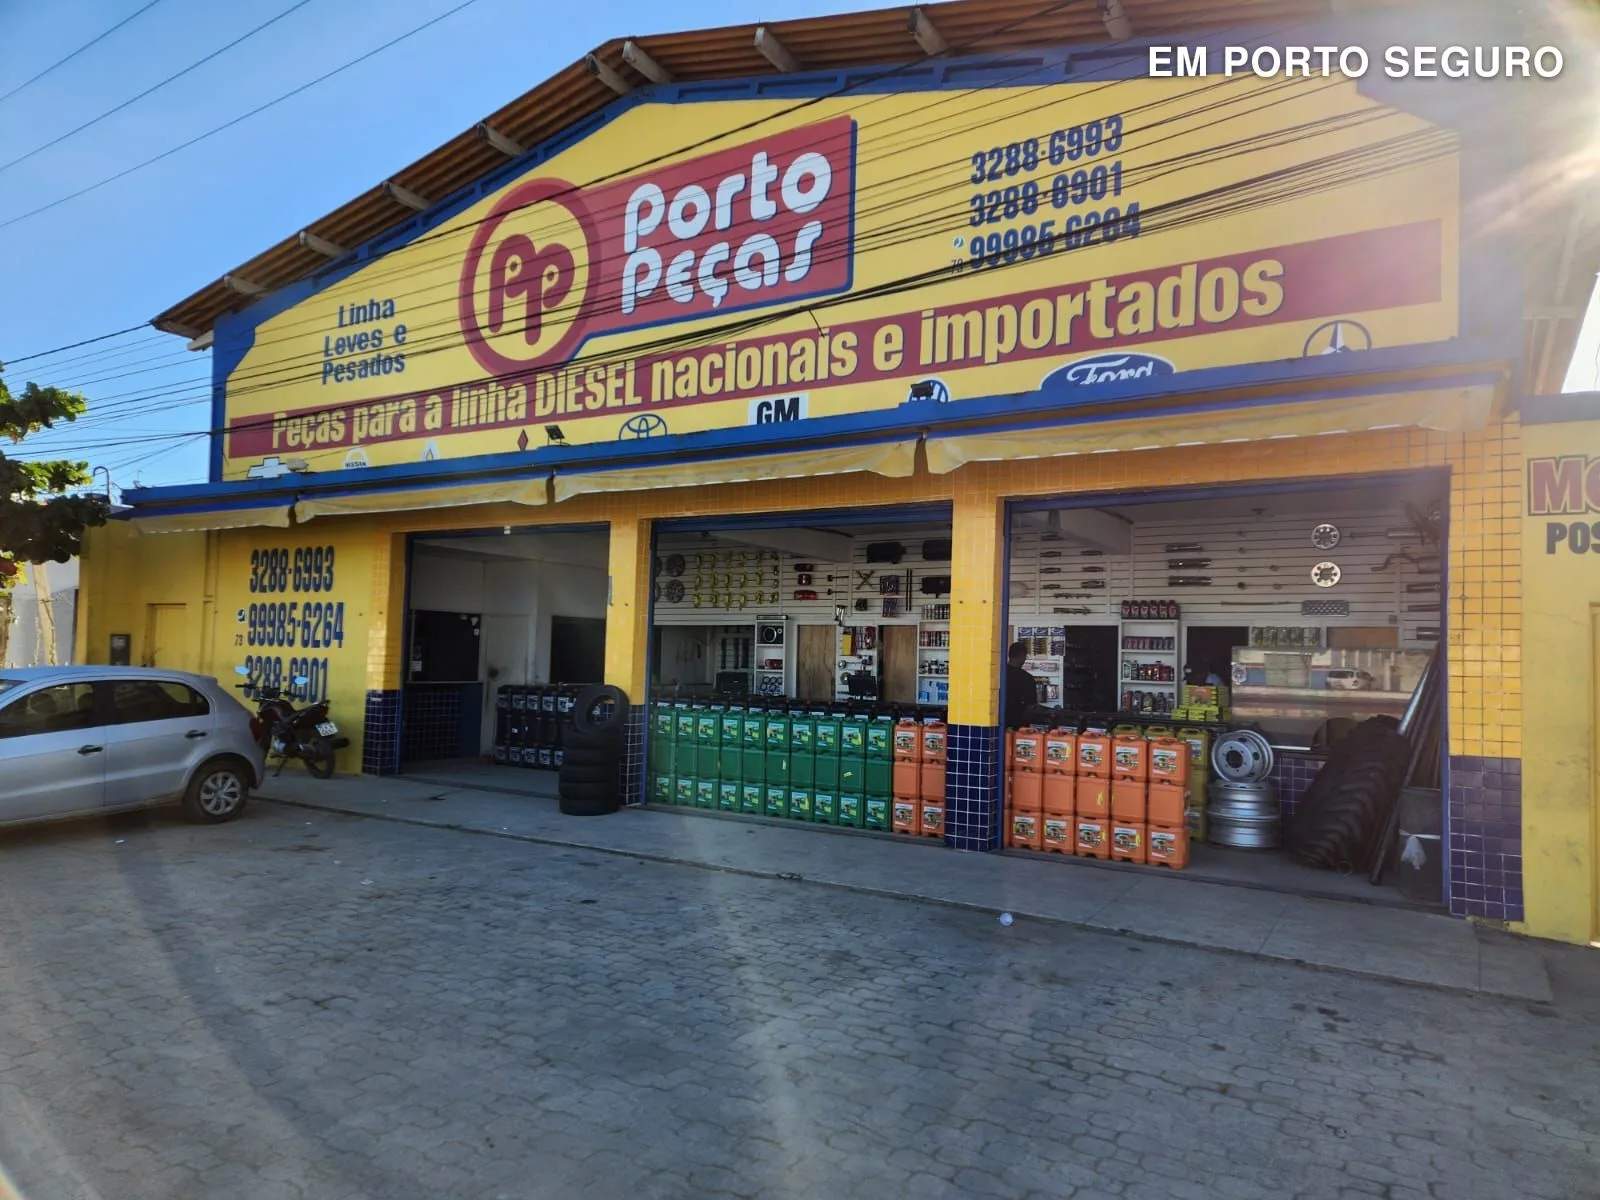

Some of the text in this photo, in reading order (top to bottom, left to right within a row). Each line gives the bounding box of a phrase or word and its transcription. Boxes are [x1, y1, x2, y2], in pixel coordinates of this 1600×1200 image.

[338, 298, 395, 329] Linha
[272, 408, 347, 449] Peças
[352, 396, 417, 443] para
[425, 394, 443, 431] a
[450, 374, 527, 428] linha
[535, 359, 643, 417] DIESEL
[651, 327, 859, 401] nacionais
[872, 322, 903, 372] e
[919, 259, 1285, 366] importados
[323, 323, 408, 358] Leves e
[322, 352, 405, 385] Pesados
[1066, 356, 1154, 385] Ford
[756, 397, 800, 425] GM
